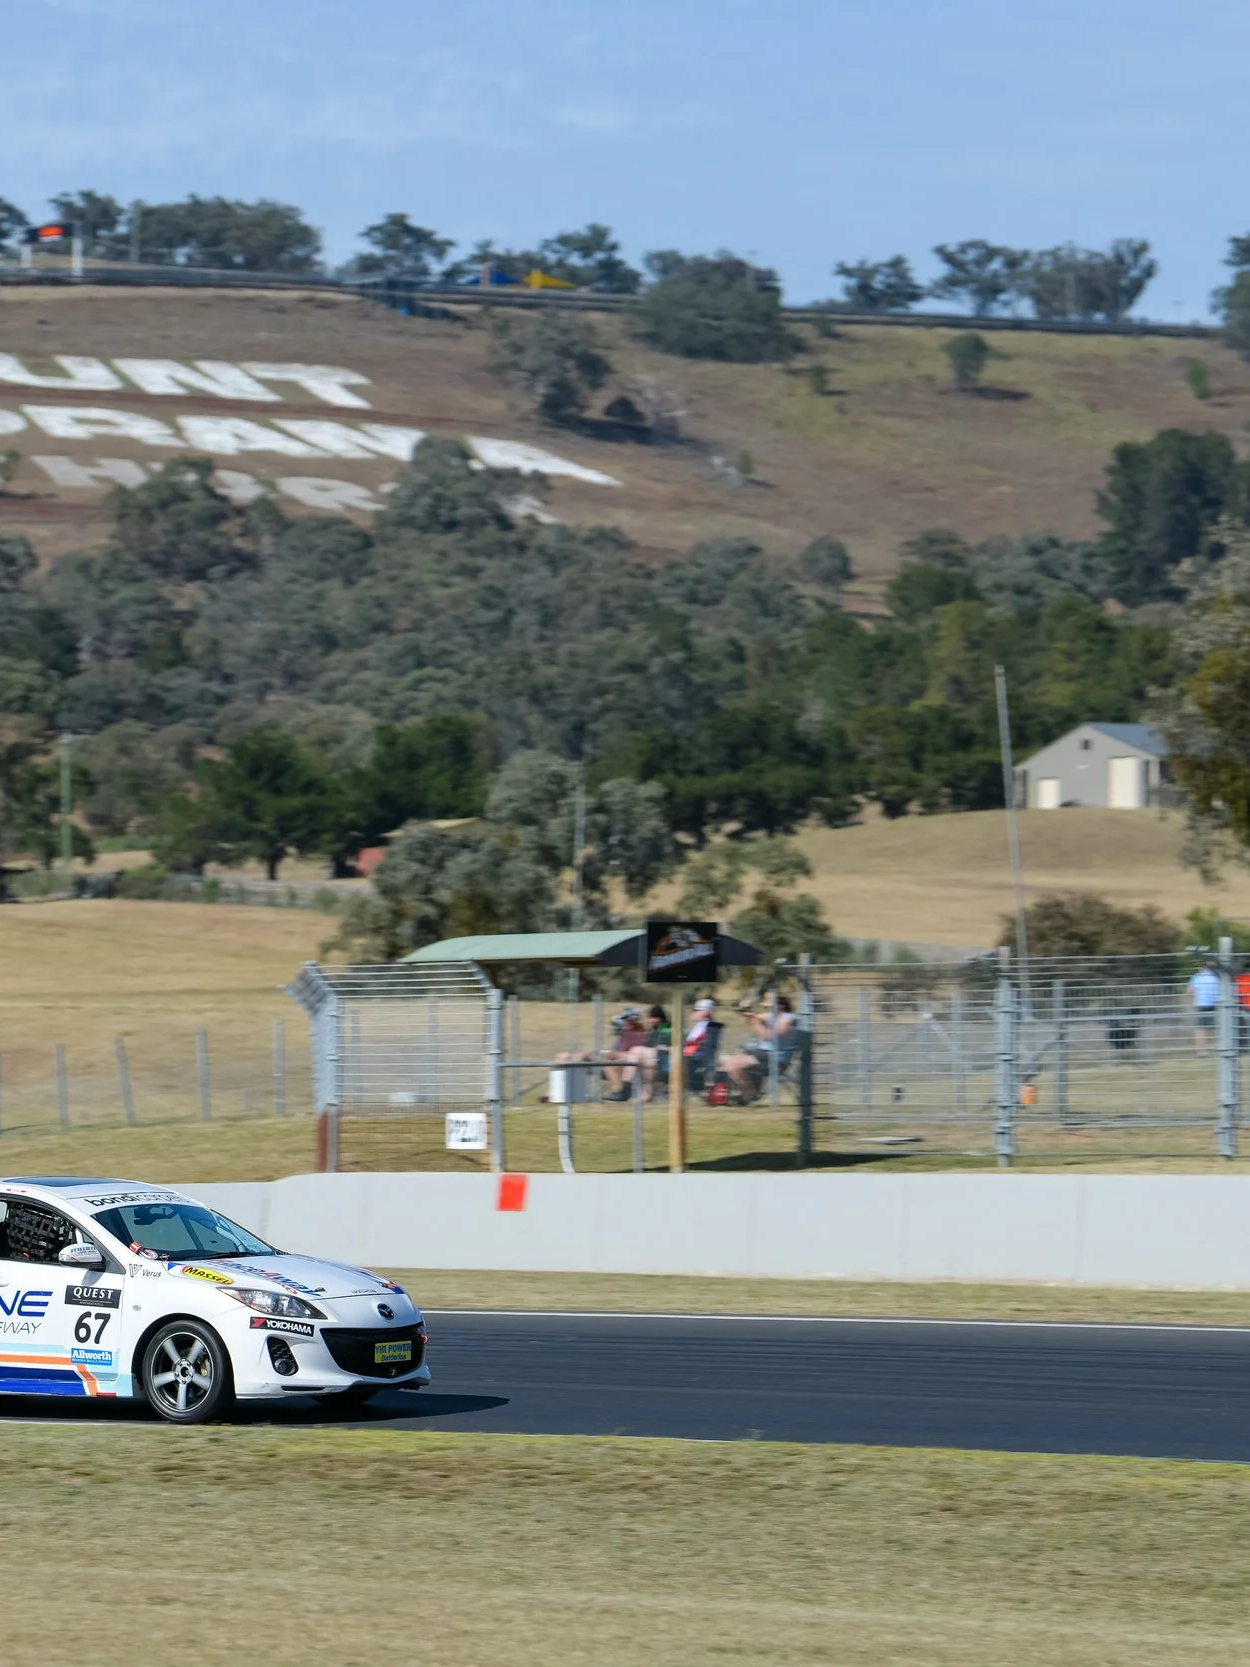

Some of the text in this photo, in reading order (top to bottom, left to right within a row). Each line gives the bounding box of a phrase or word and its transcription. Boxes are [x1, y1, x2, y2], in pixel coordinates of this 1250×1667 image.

[142, 1269, 162, 1278] Verus
[73, 1286, 114, 1299] QUEST
[74, 1311, 111, 1345] 67
[265, 1318, 312, 1335] YOKOHAMA
[388, 1343, 413, 1353] POWER
[72, 1350, 112, 1361] Allworth
